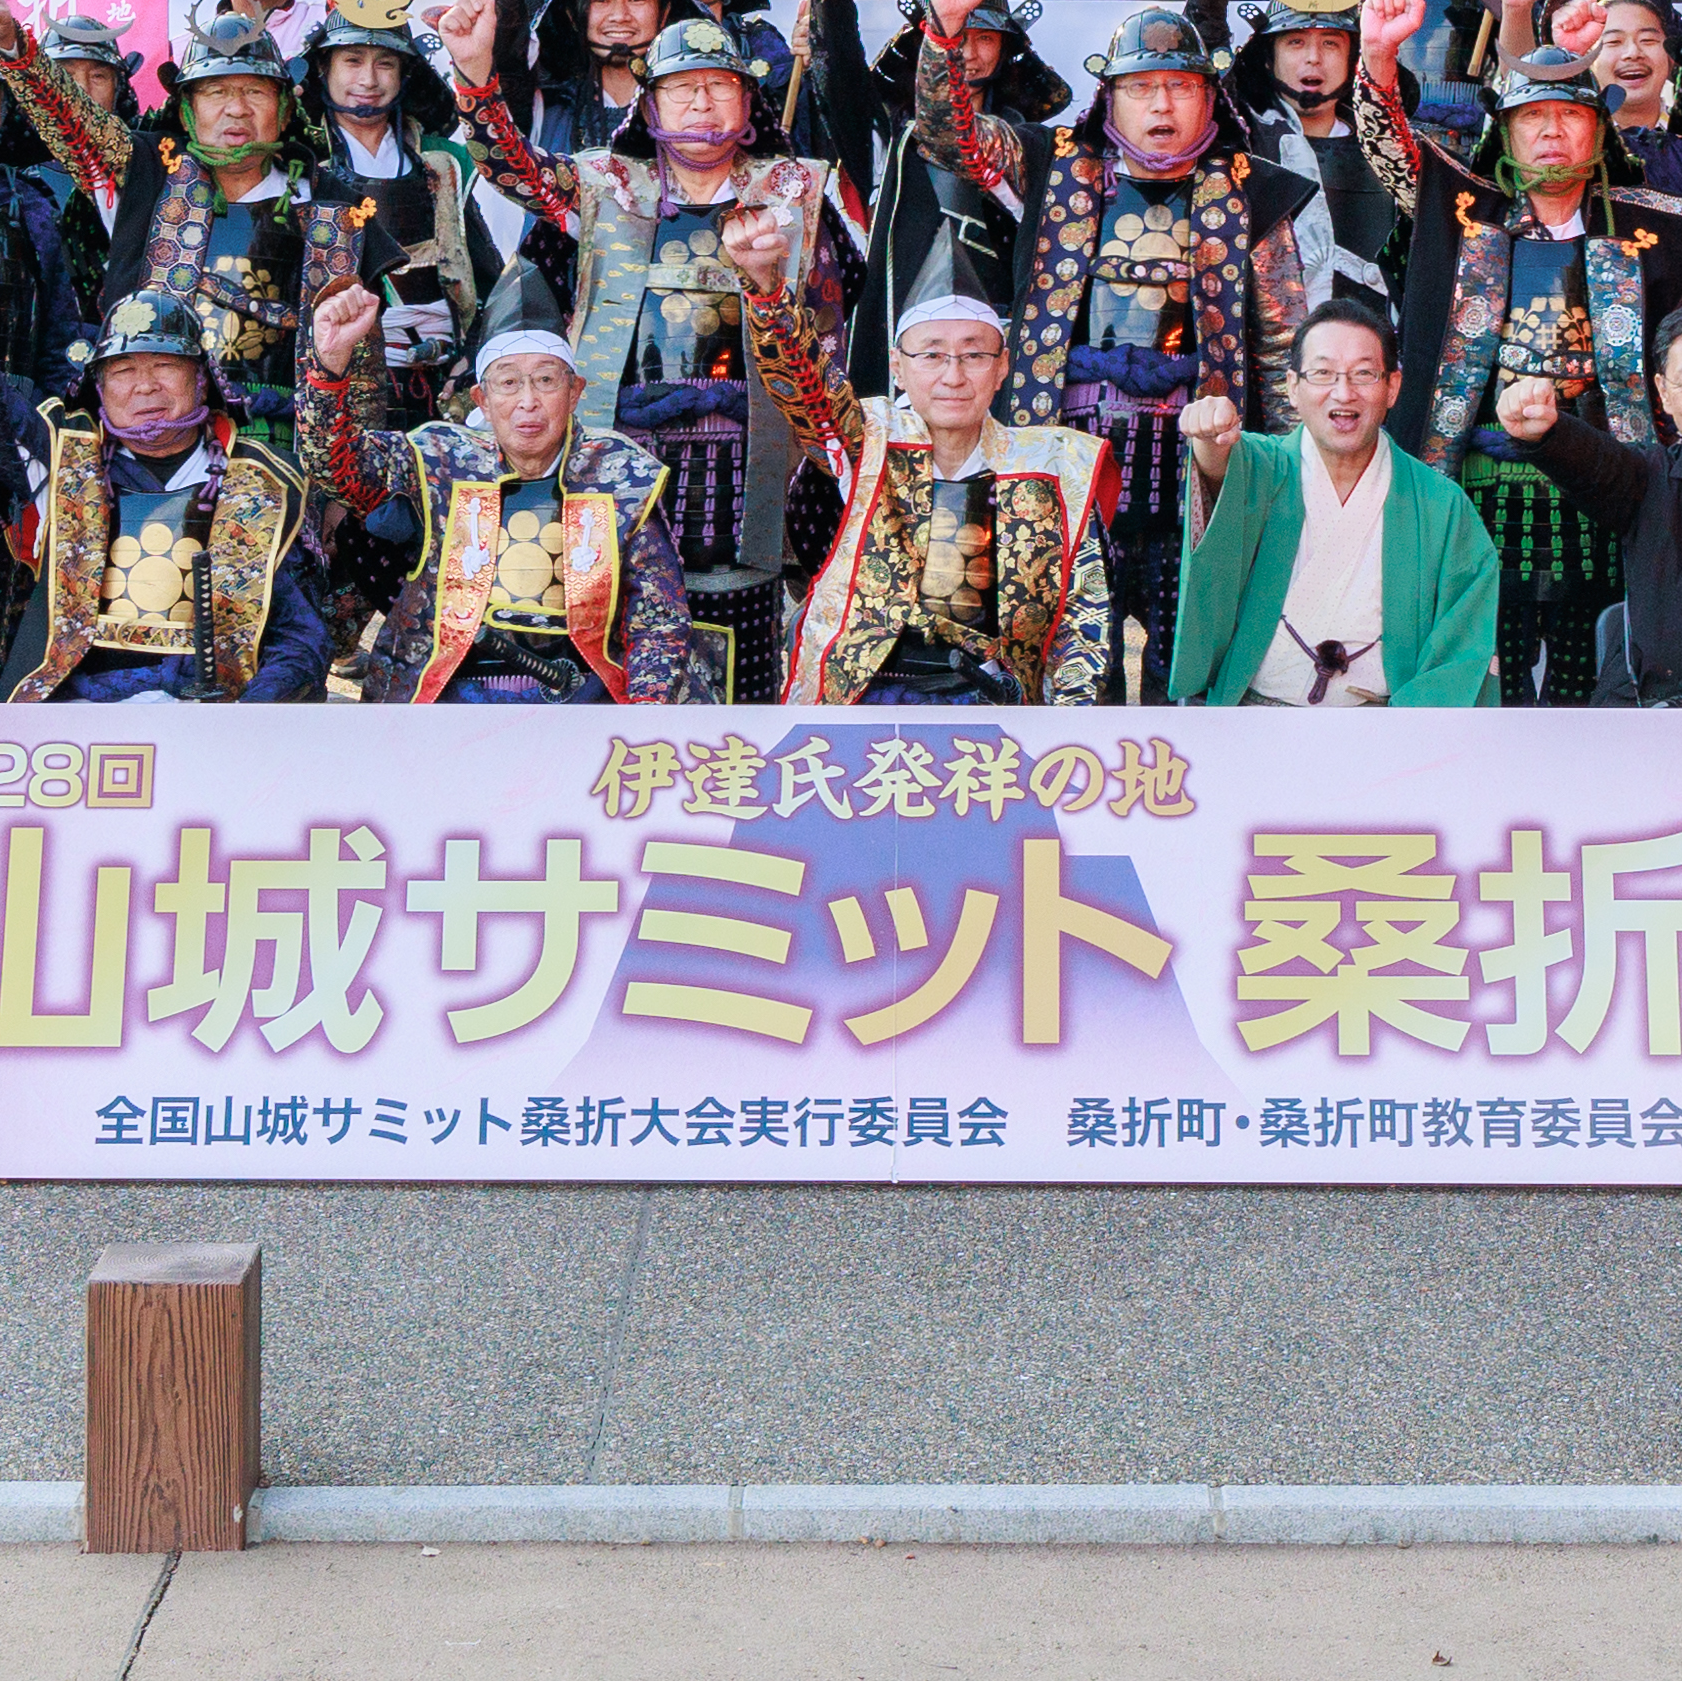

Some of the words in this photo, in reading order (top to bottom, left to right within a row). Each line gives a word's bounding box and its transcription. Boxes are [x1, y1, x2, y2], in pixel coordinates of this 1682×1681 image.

[594, 735, 1194, 820] 伊達氏発祥の地
[96, 1095, 1009, 1147] 全国山城サミット桑折大会実行委員会
